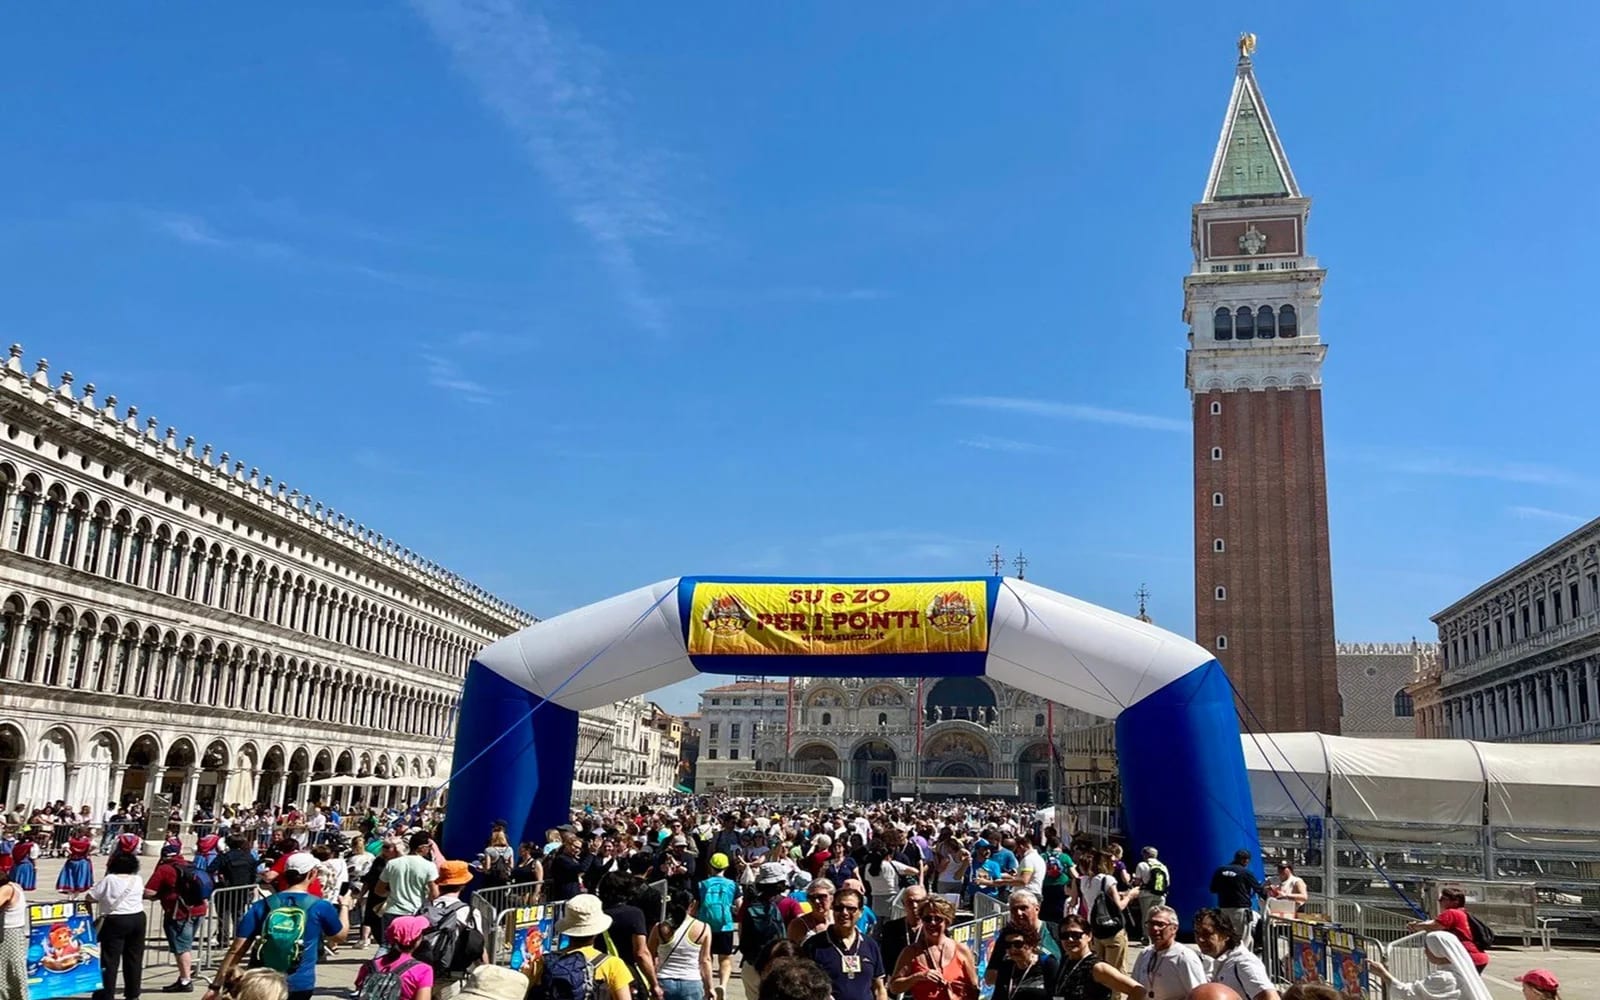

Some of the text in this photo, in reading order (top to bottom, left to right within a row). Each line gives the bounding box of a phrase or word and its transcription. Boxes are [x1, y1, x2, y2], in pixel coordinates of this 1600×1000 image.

[788, 589, 890, 604] SU e ZO
[756, 612, 806, 632] PER
[814, 613, 824, 630] I
[831, 610, 920, 630] PONTI
[801, 632, 884, 641] www.suezo.it
